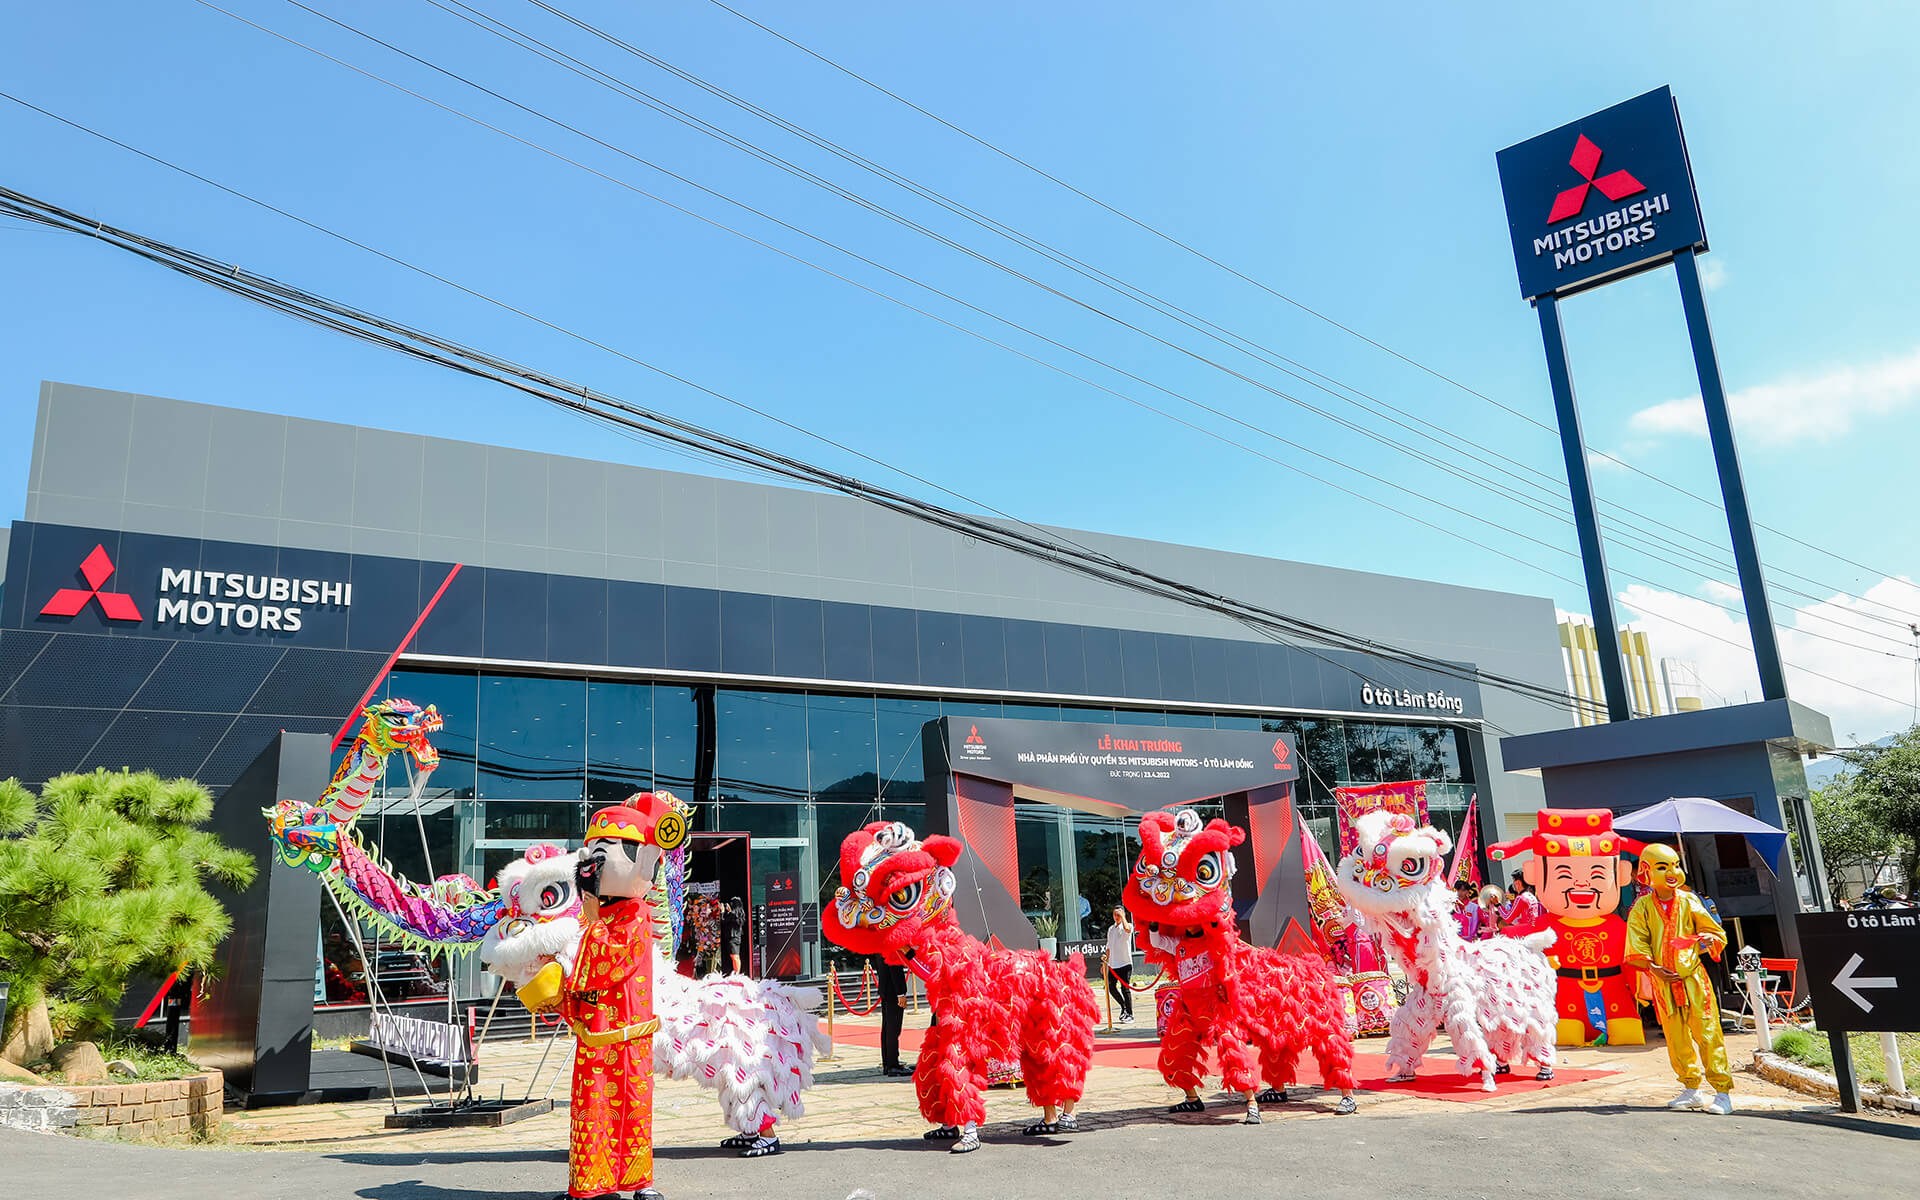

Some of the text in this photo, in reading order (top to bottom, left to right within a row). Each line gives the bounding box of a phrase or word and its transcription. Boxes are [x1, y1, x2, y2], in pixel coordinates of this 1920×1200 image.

[1533, 193, 1671, 256] MITSUBISHI
[1554, 220, 1656, 270] MOTORS
[160, 567, 352, 606] MITSUBISHI
[157, 598, 302, 632] MOTORS
[1362, 682, 1464, 714] Ô tô Lâm Đồng
[1098, 734, 1183, 753] LỄ KHAI TRƯƠNG
[1017, 752, 1035, 763] NHÀ
[1036, 752, 1058, 764] PHÂN
[1060, 752, 1078, 764] PHỐI
[1118, 757, 1128, 766] 3S
[1128, 757, 1169, 767] MITSUBISHI
[1170, 758, 1199, 768] MOTORS
[1219, 758, 1235, 769] LÂM
[1143, 771, 1170, 779] 23.4.2022
[1847, 913, 1858, 928] Ô
[1860, 915, 1879, 928] tô
[1881, 914, 1916, 927] Lâm
[1064, 943, 1107, 957] Nơi đậu x
[1574, 937, 1599, 961] 寶
